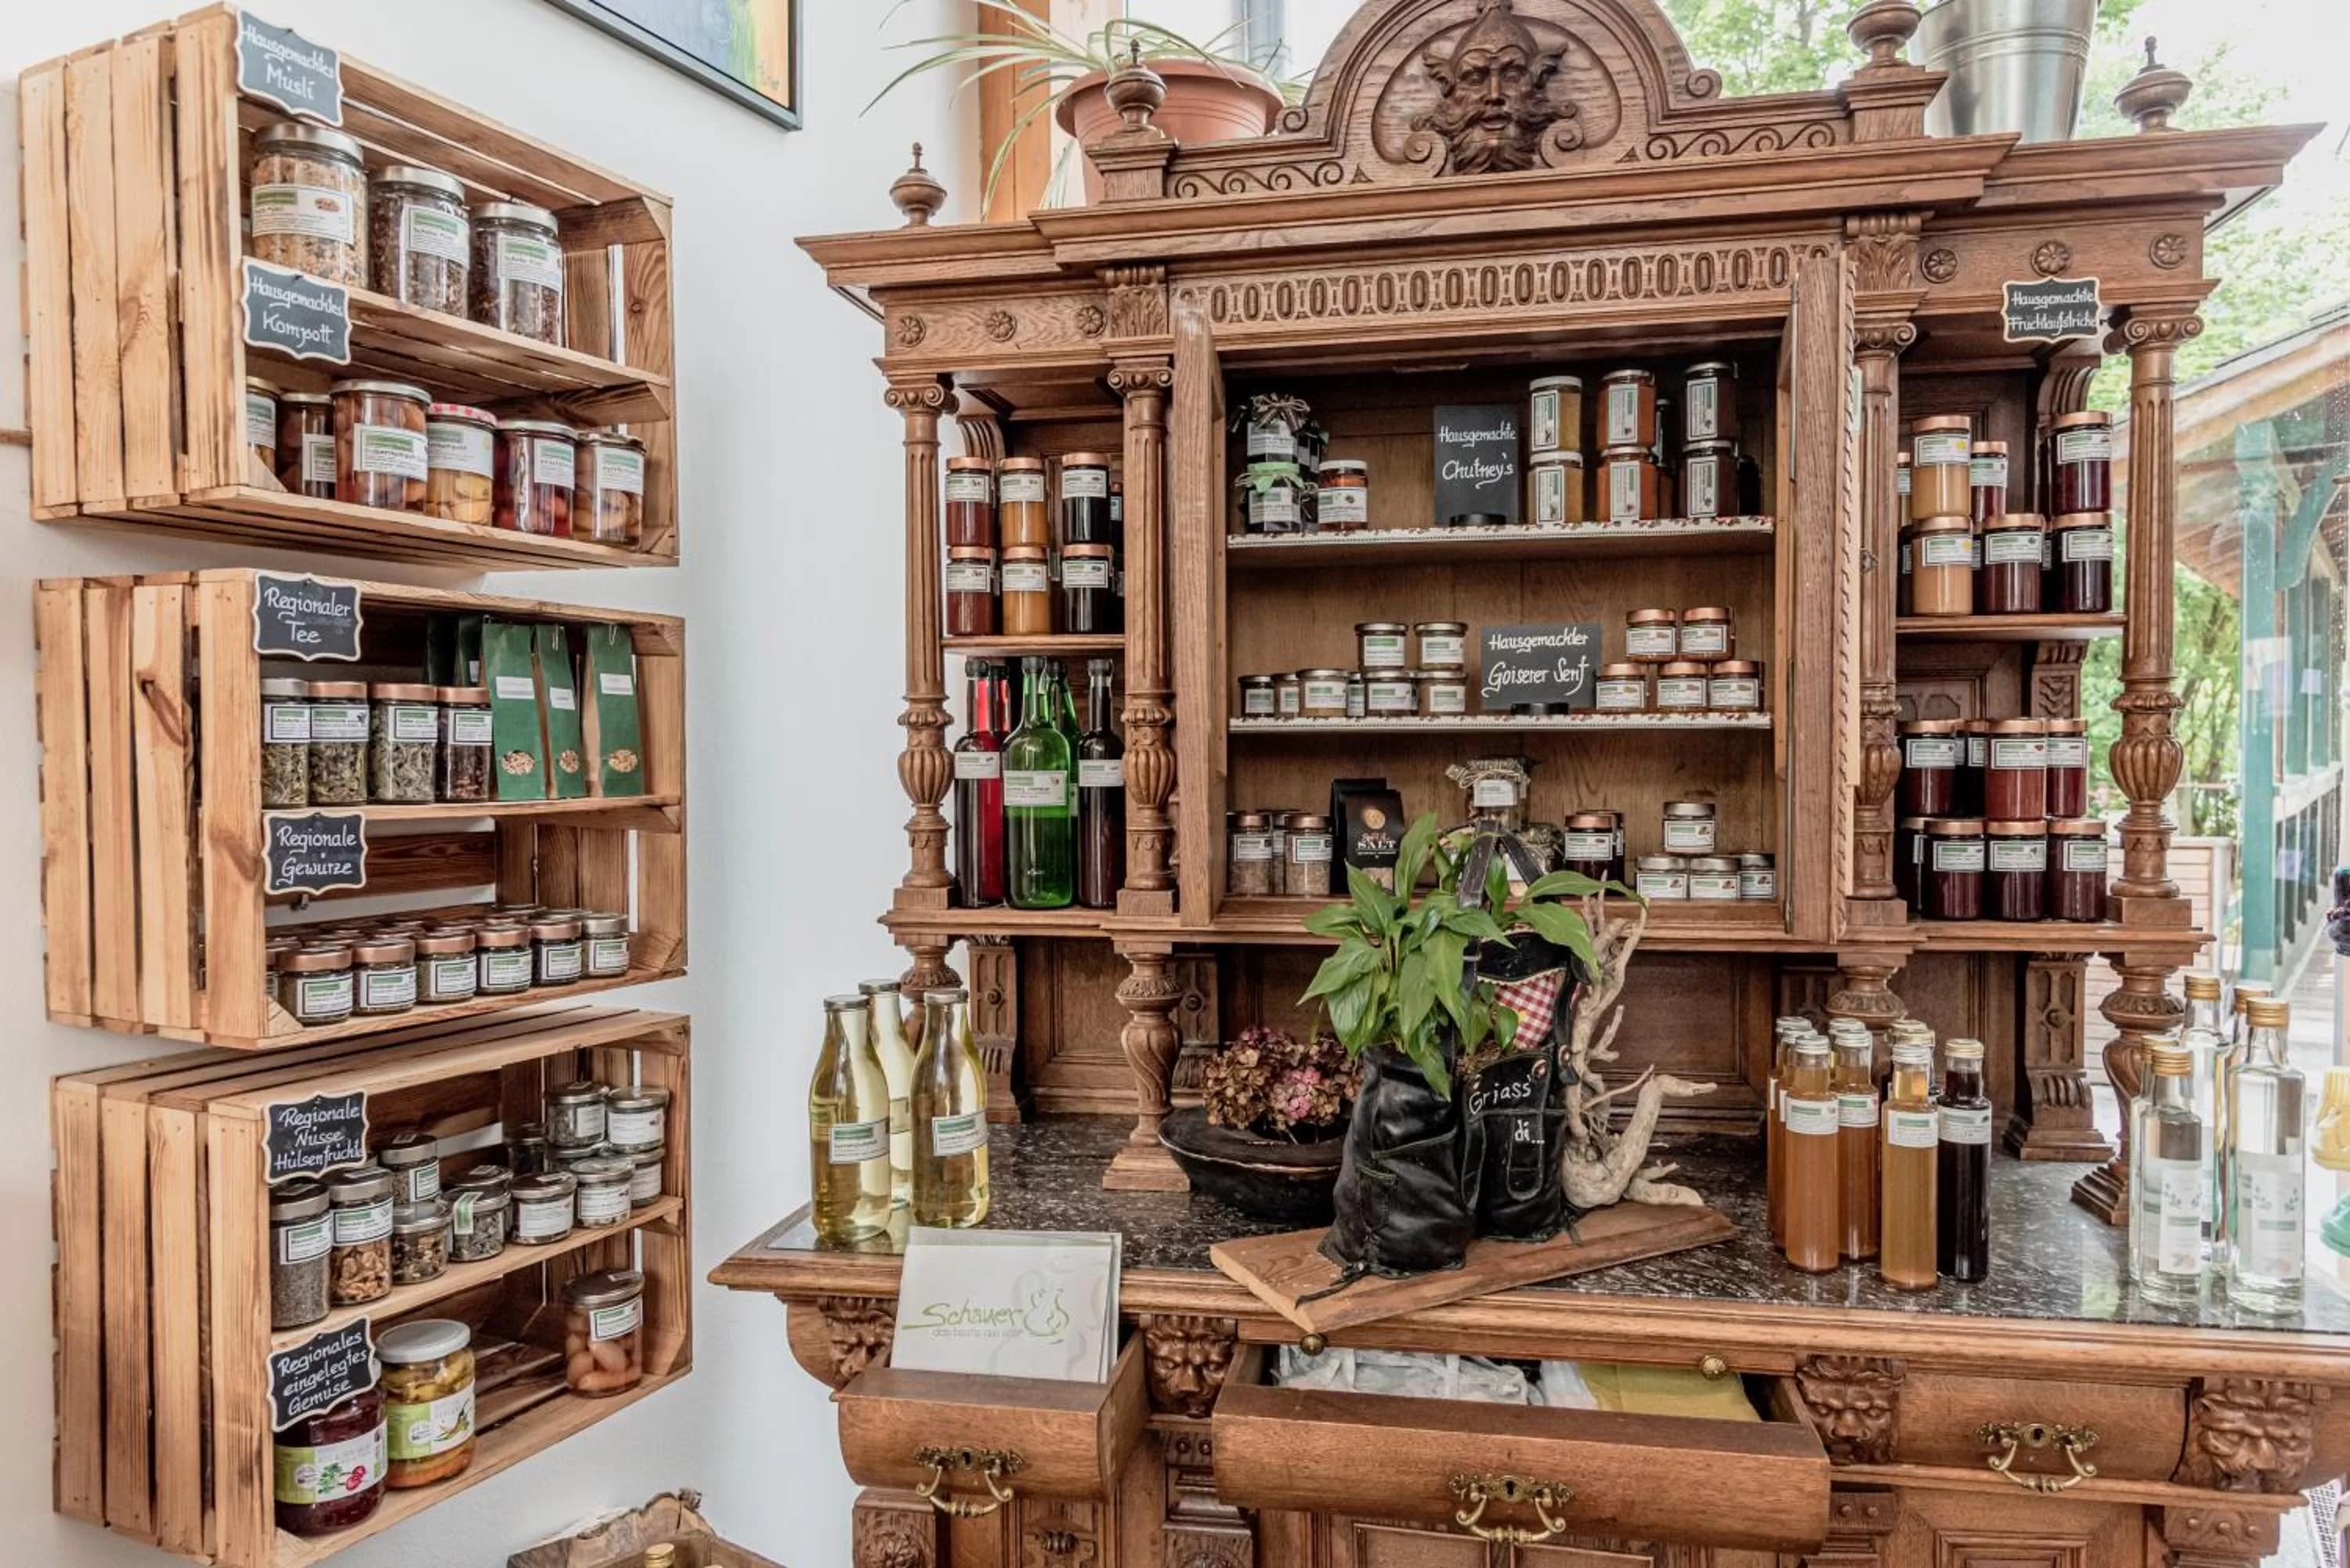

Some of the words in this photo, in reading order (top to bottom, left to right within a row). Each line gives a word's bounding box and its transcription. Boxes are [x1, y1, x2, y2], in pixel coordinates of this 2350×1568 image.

[241, 23, 334, 78] Hausgemachtes
[266, 62, 316, 99] Müsli
[250, 275, 344, 317] Hausgemachtes
[2011, 287, 2095, 311] Hausgemachte
[262, 309, 335, 349] Kompott
[1438, 419, 1517, 448] Hausgemachte
[1442, 451, 1515, 490] Chutney's
[263, 586, 352, 620] Regionaler
[284, 620, 322, 643] Tee
[1488, 626, 1589, 654] Hausgemachter
[1480, 660, 1549, 698] Goiserer
[1553, 655, 1590, 696] Senf
[276, 823, 357, 854] Regionale
[275, 852, 353, 887] Gewürze
[277, 1097, 360, 1136] Regionale
[295, 1125, 345, 1147] Nüsse
[277, 1331, 363, 1378] Regionales
[283, 1348, 367, 1396] eingelegtes
[287, 1378, 352, 1417] Gemüse
